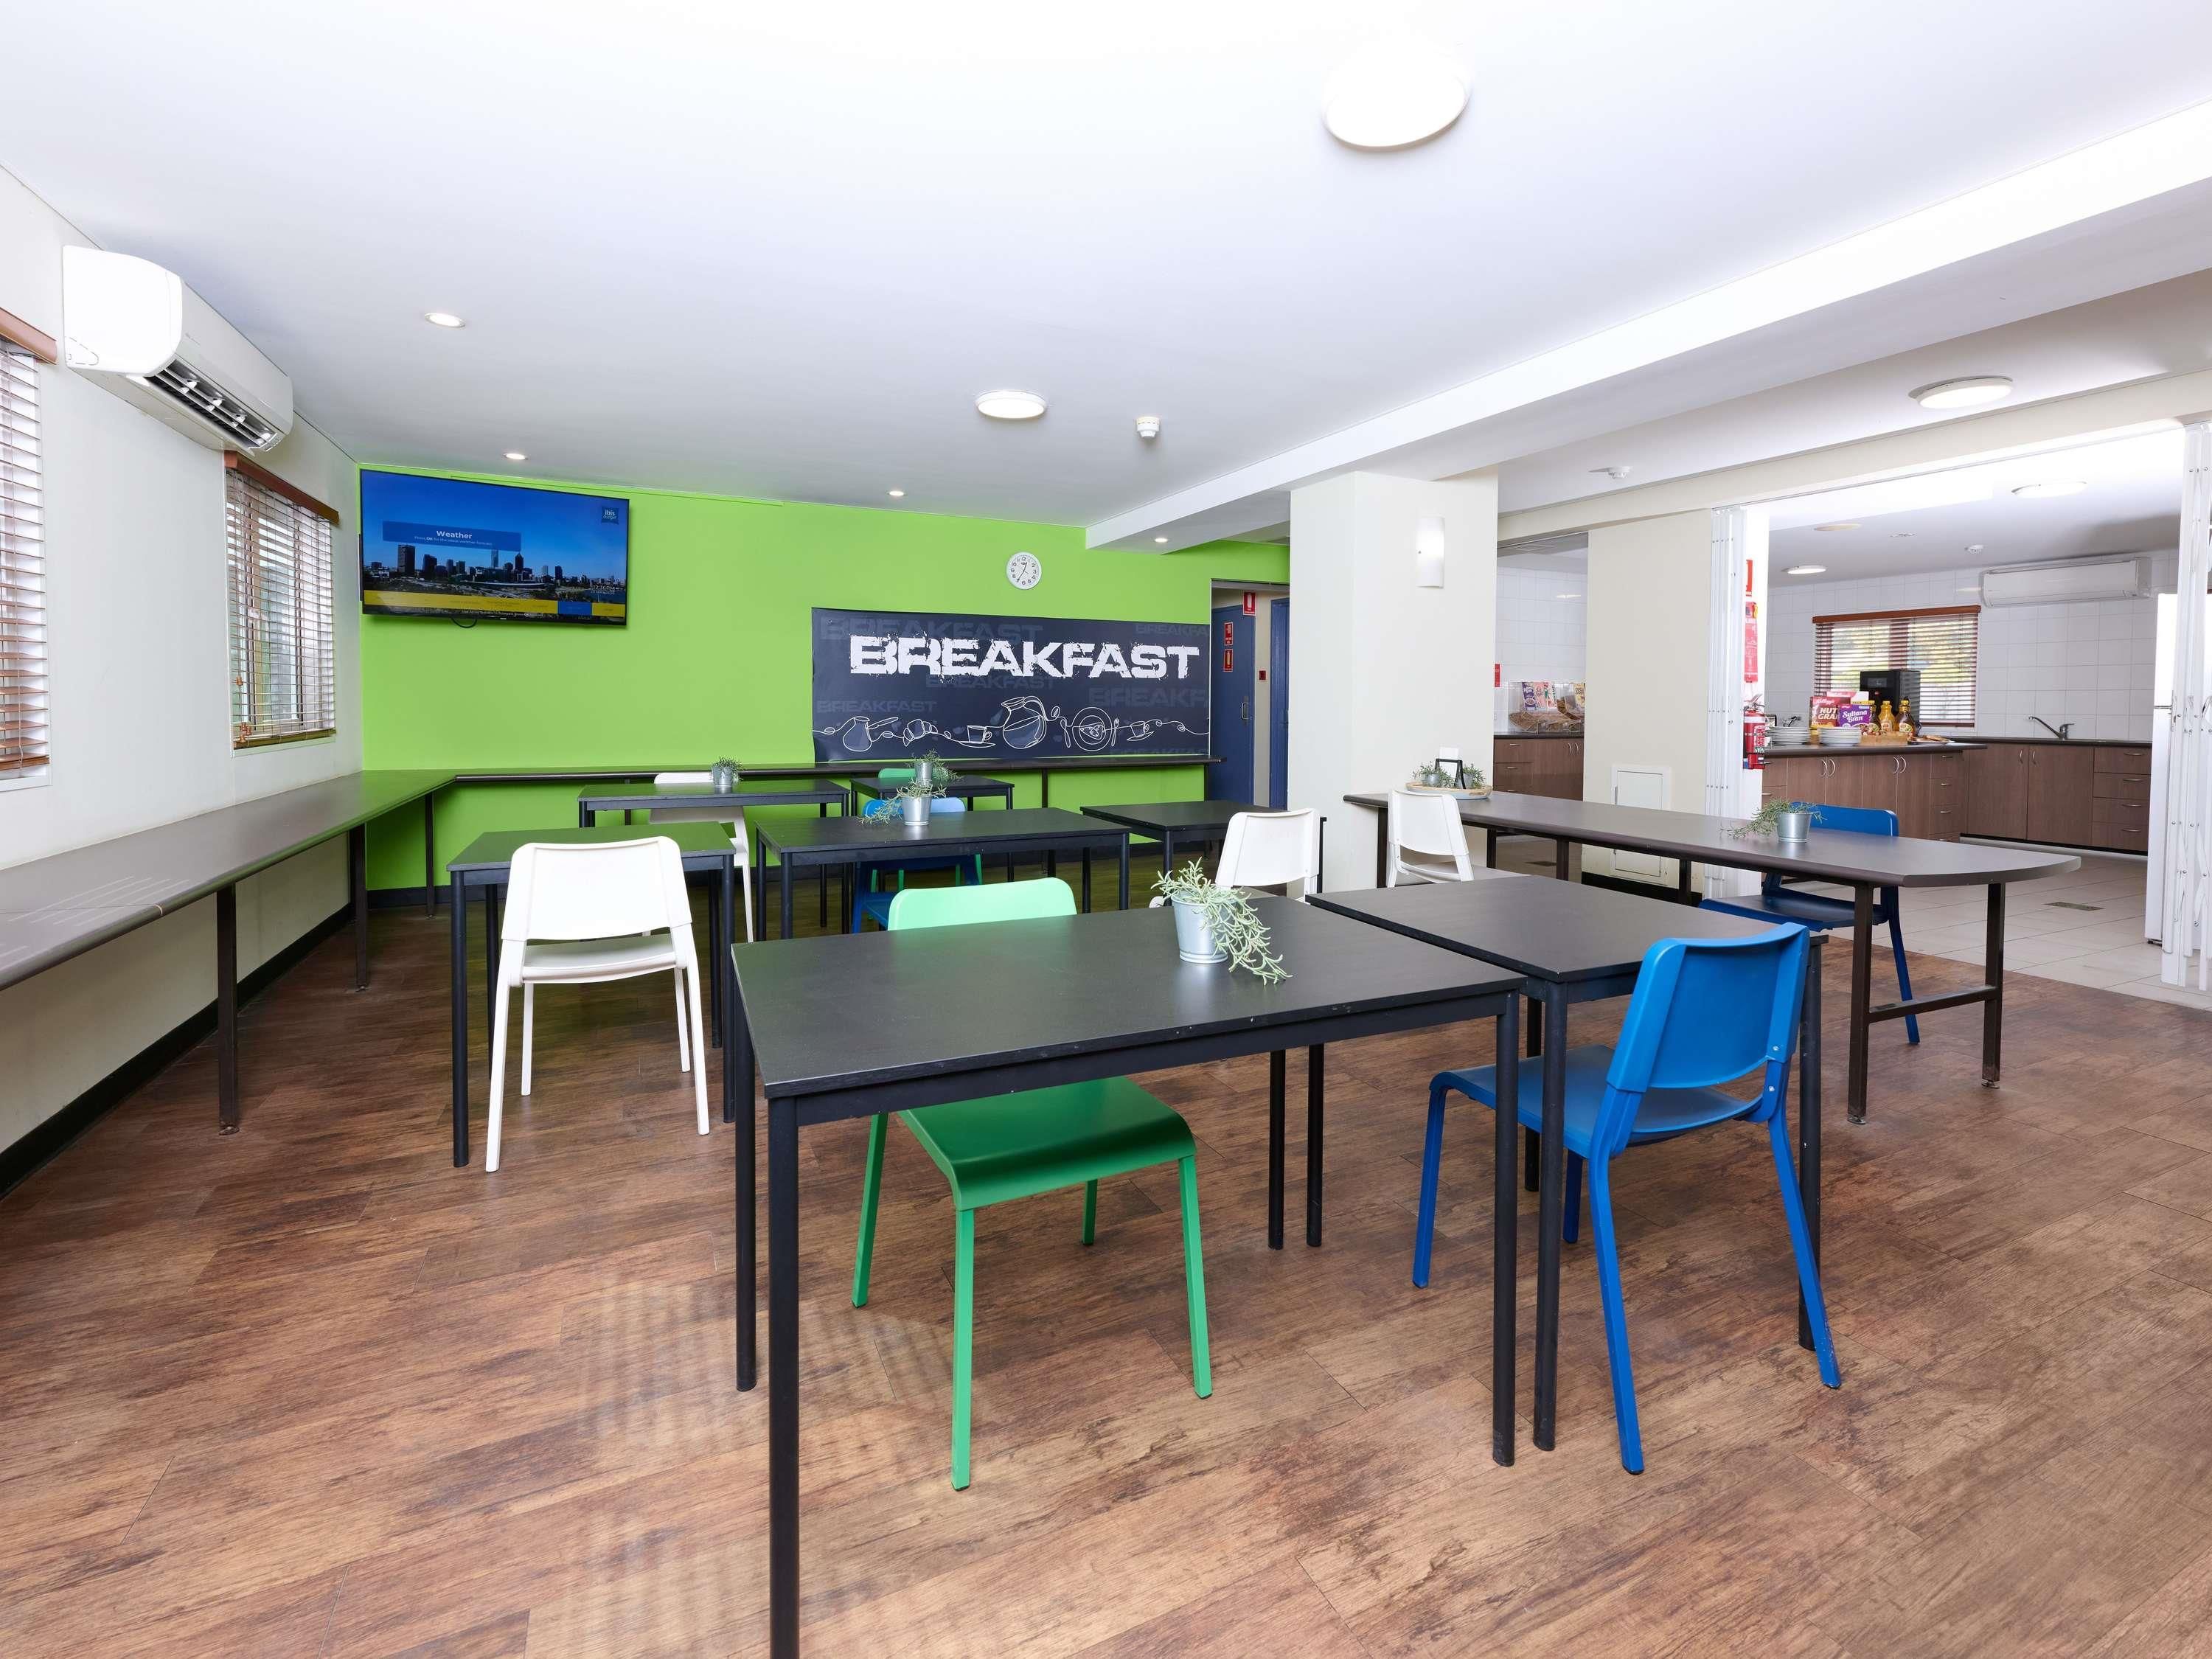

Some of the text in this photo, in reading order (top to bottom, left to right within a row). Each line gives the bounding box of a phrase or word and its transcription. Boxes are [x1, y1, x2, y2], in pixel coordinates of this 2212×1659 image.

[436, 530, 473, 539] Weather
[850, 635, 1200, 680] BREAKFAST
[816, 700, 937, 714] BREAKFAST
[1842, 710, 1868, 718] Sultana
